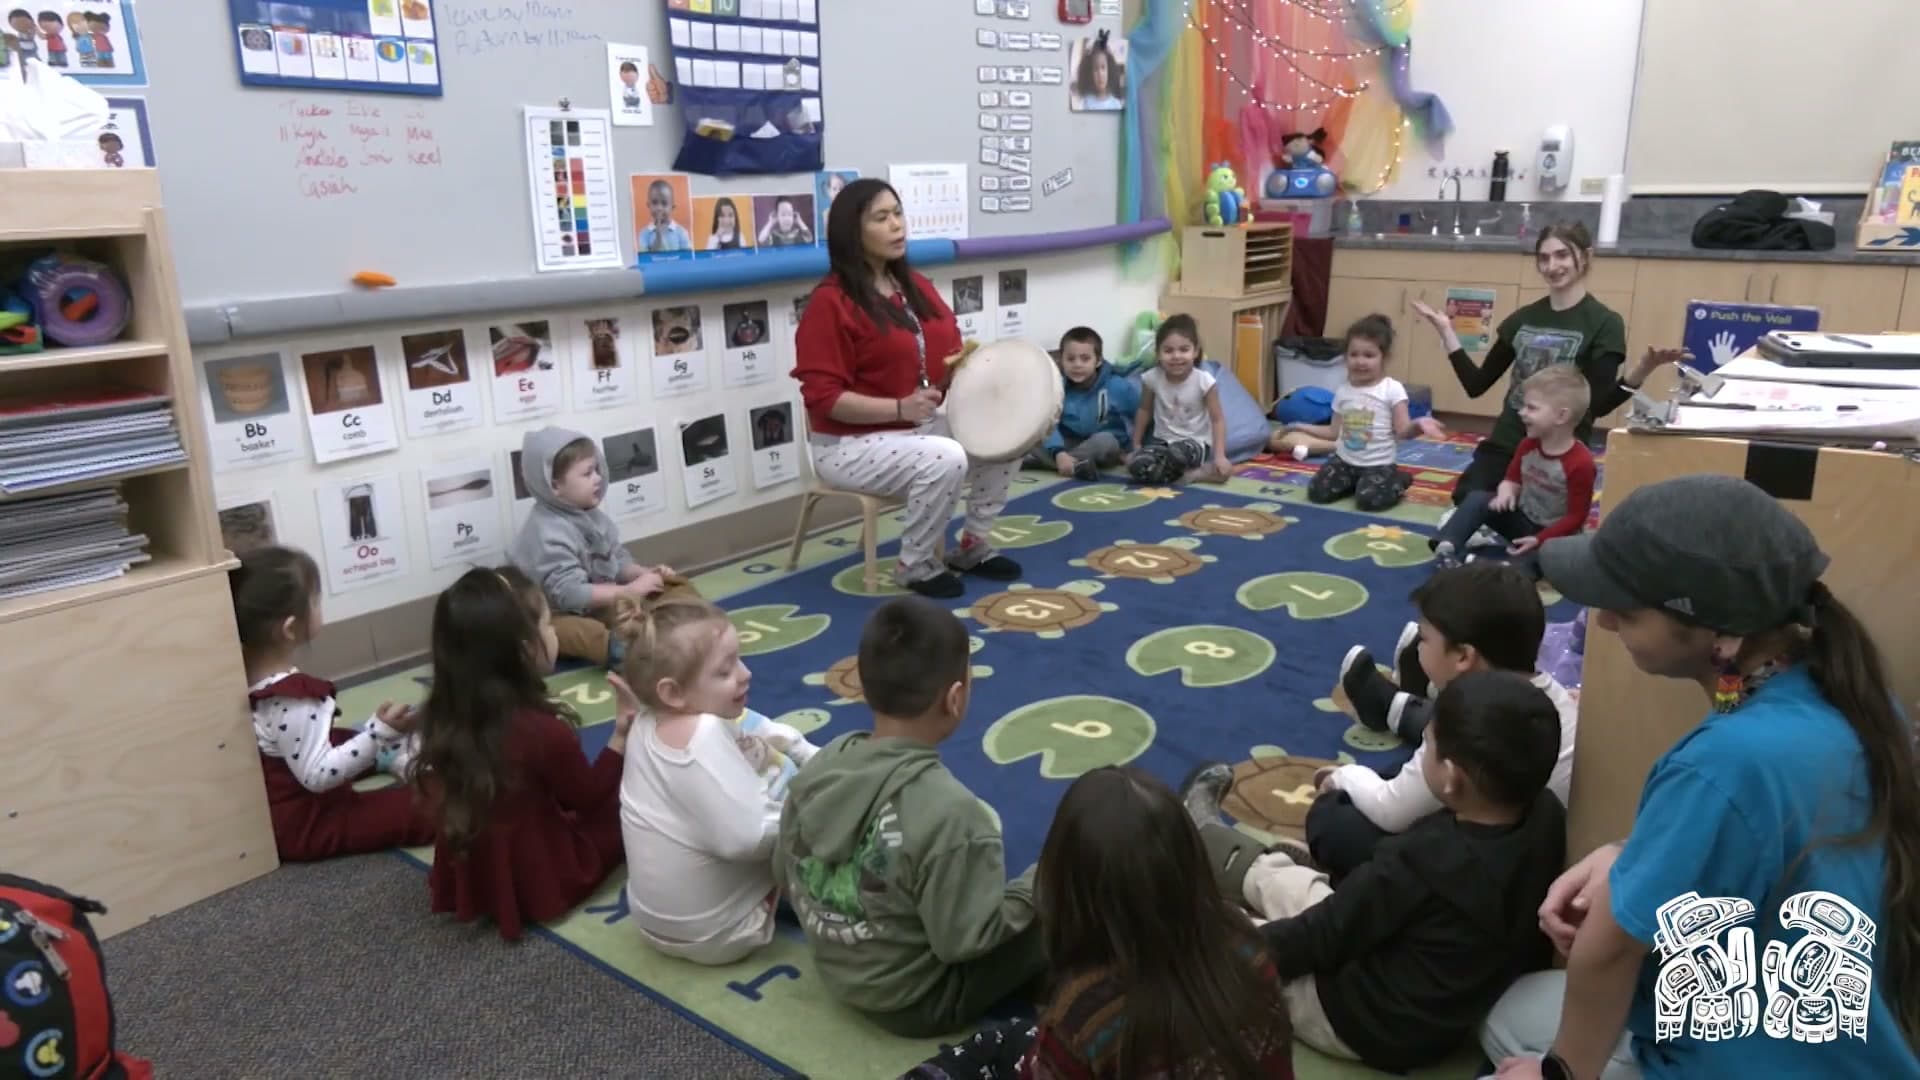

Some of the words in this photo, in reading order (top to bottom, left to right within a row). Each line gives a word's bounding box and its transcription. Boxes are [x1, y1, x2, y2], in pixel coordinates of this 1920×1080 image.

[1710, 311, 1739, 321] Push
[1742, 312, 1762, 323] the
[1765, 313, 1792, 325] Wall
[518, 378, 535, 393] Ee
[433, 390, 452, 405] Dd
[342, 413, 361, 428] Cc
[245, 422, 267, 438] Bb
[457, 523, 473, 538] Pp
[357, 544, 379, 559] Oo
[1114, 551, 1170, 569] 12
[1005, 598, 1065, 620] 13
[1184, 640, 1235, 659] 8
[726, 964, 801, 1001] J
